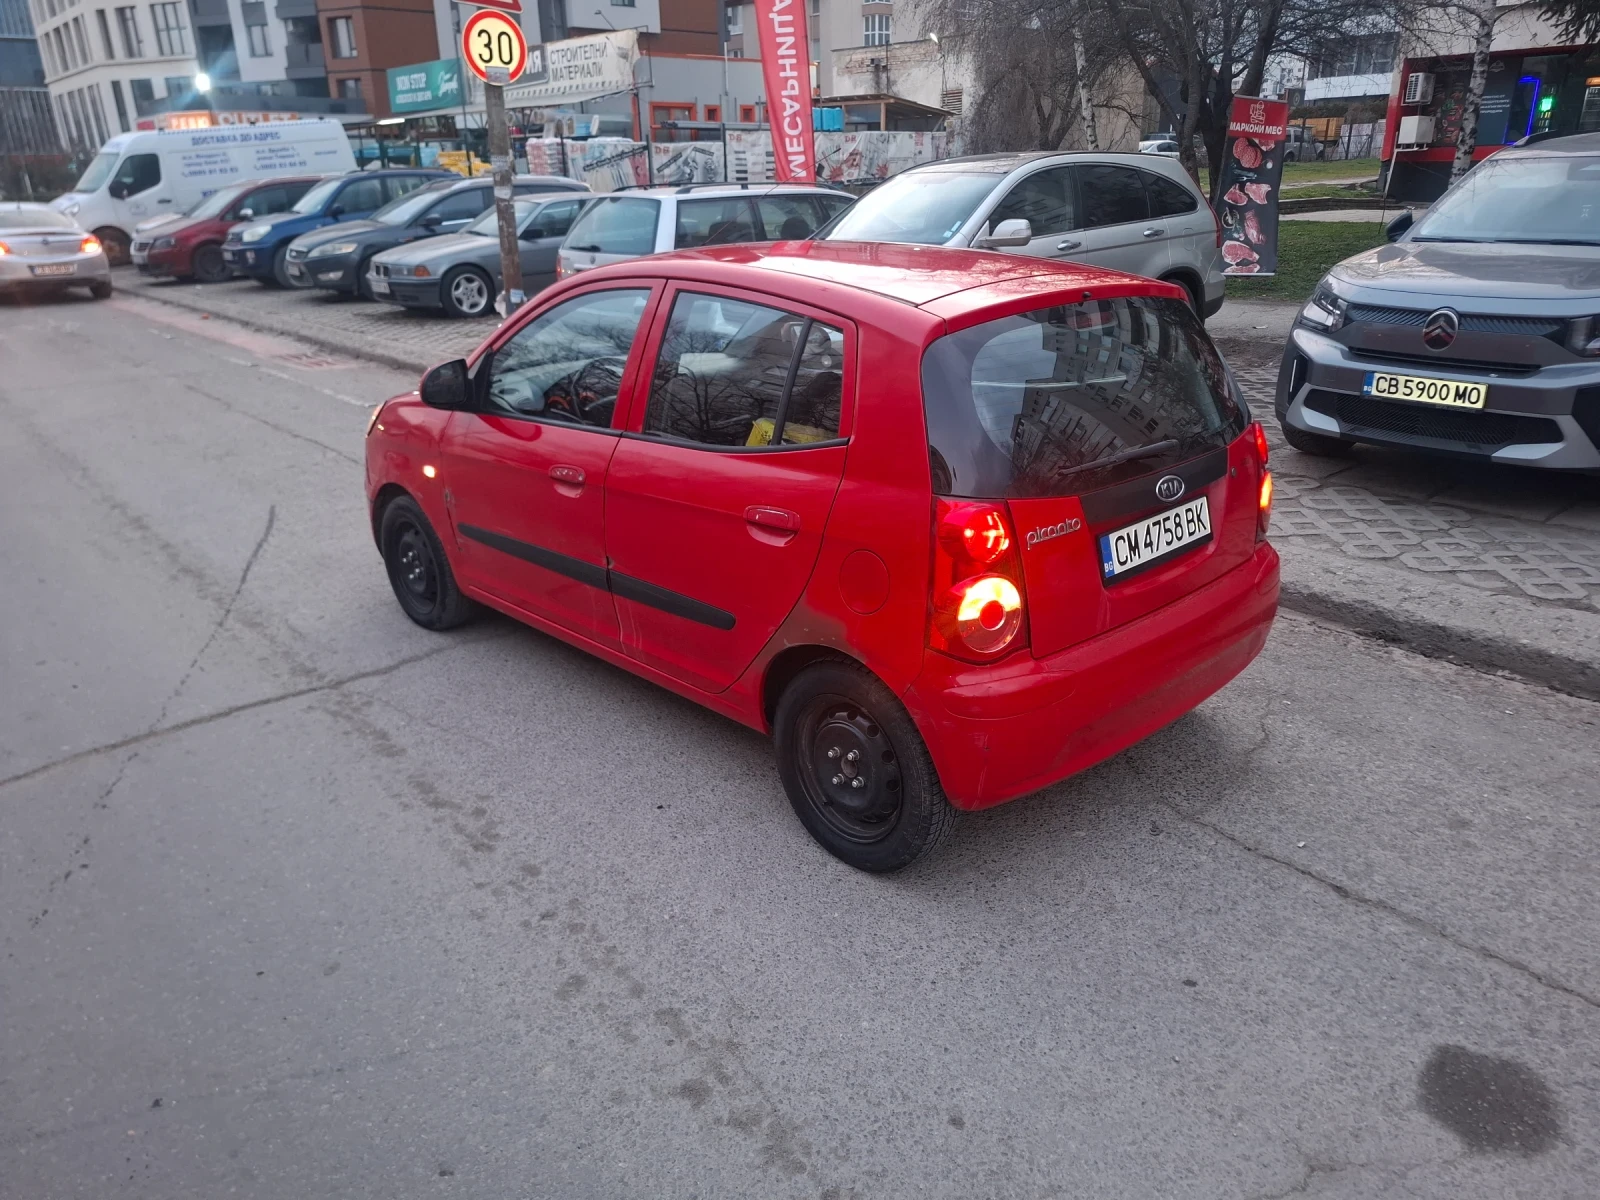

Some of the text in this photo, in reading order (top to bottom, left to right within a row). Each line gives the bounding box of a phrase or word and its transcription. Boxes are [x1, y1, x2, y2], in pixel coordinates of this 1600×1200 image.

[477, 29, 513, 65] 30
[550, 42, 608, 65] СТРОИТЕЛНИ
[526, 50, 542, 75] ИЯ
[551, 60, 604, 82] МАТЕРИАЛИ
[410, 72, 427, 89] STOP
[191, 131, 281, 146] ДОСТАВКА ДО АДРЕС
[1229, 122, 1283, 135] МАРКОНИ МЕС
[1375, 376, 1481, 405] CB 5900 MO
[1027, 517, 1081, 550] picanto
[1104, 562, 1114, 573] BG
